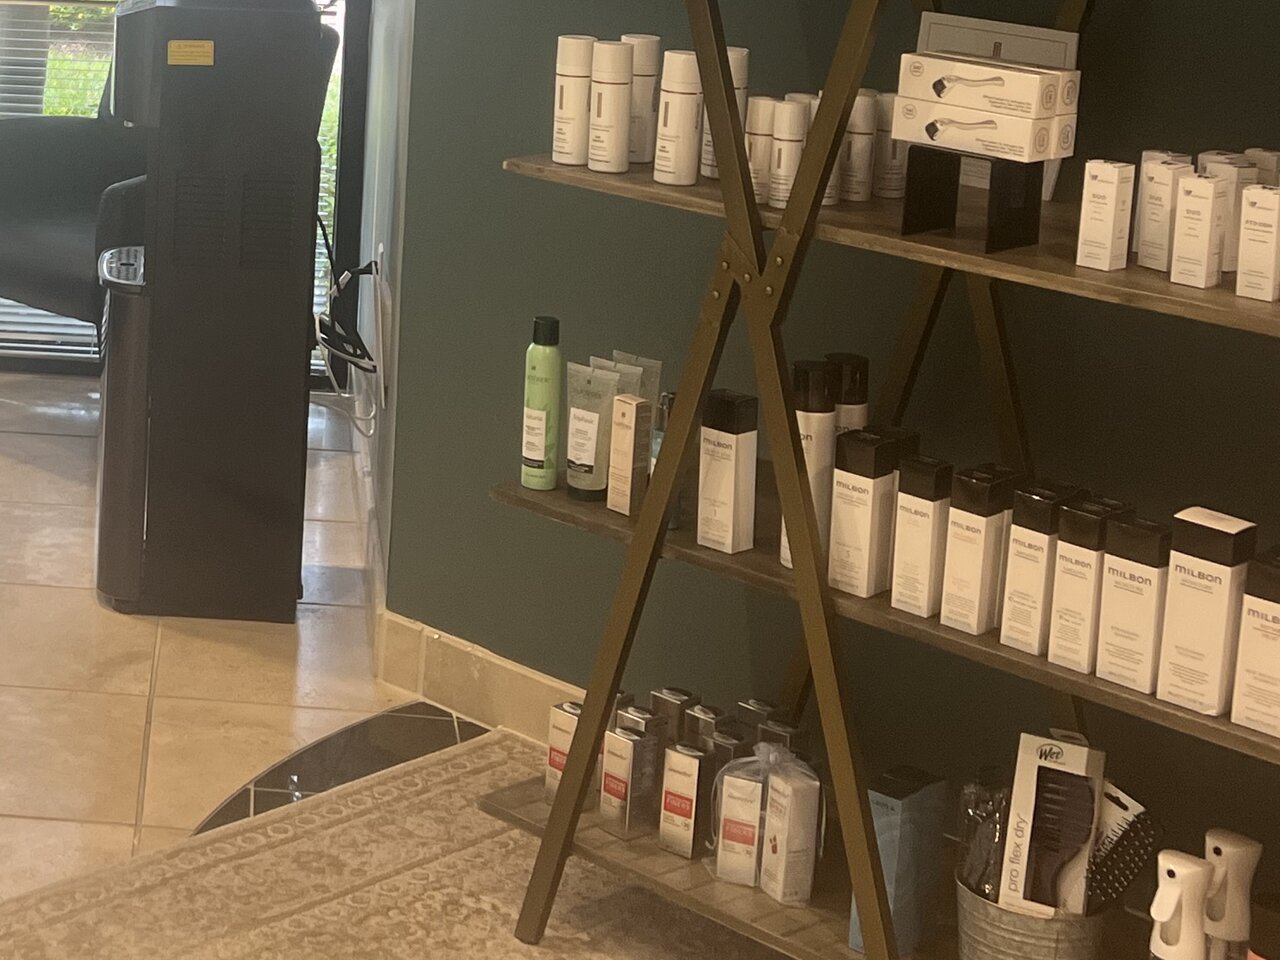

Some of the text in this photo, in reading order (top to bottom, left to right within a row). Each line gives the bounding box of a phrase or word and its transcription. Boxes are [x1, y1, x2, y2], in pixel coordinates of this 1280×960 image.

[1247, 608, 1280, 624] MILB
[1008, 813, 1029, 893] pro flex dry
